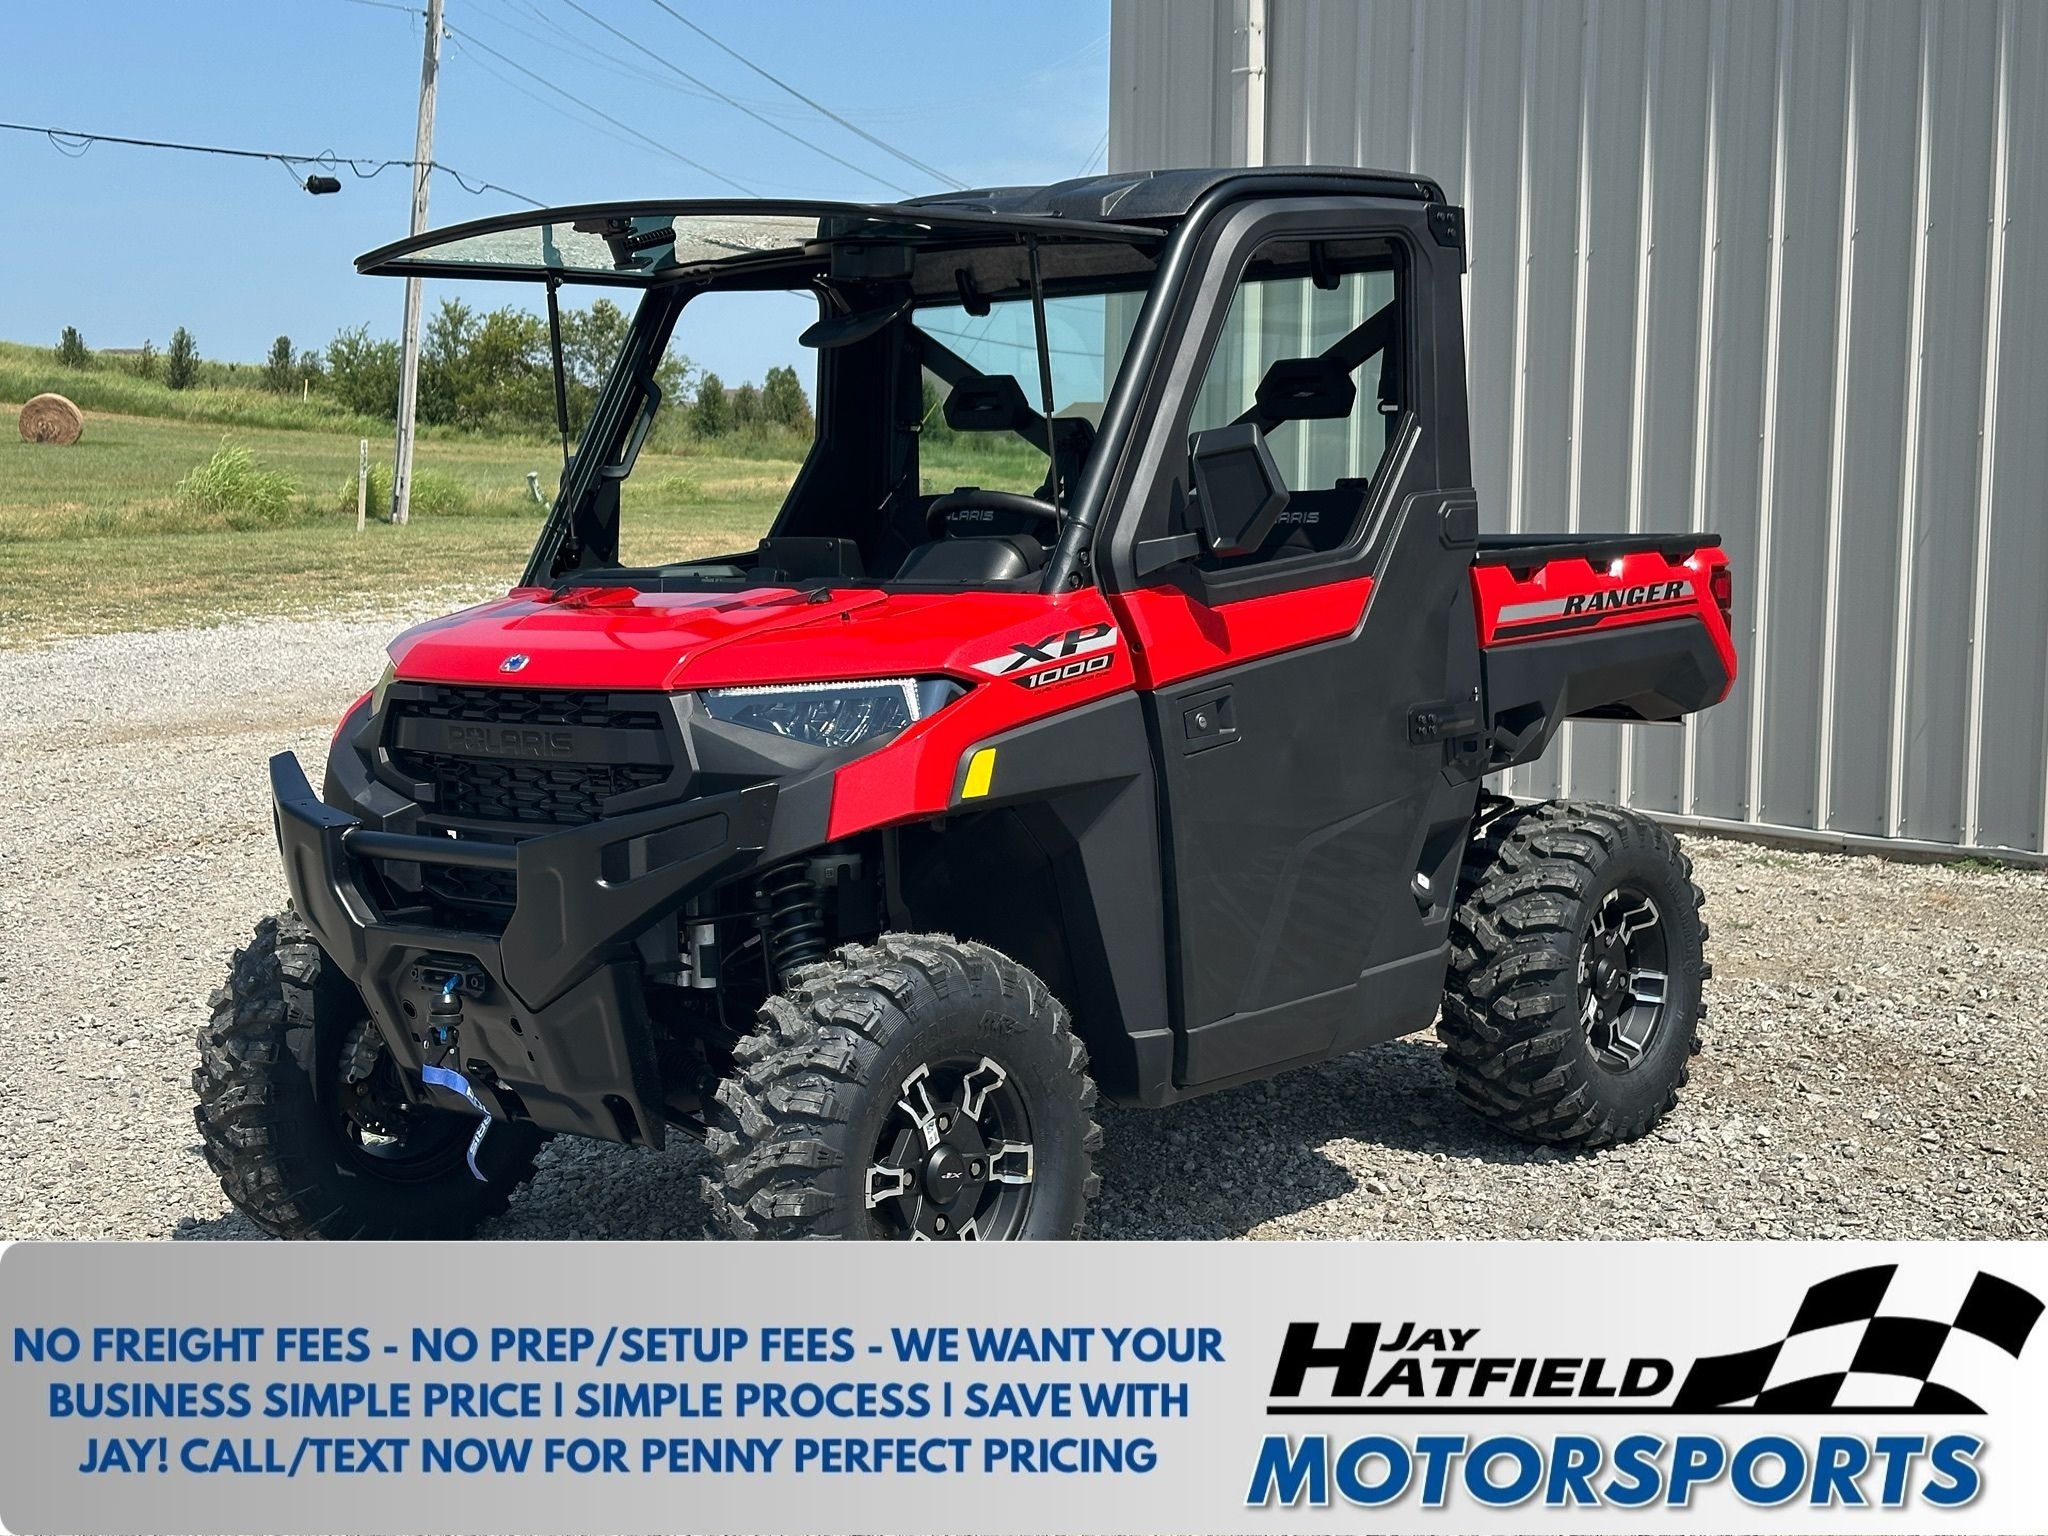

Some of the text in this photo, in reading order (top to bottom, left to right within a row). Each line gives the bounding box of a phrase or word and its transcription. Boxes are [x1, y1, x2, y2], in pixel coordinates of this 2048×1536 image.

[944, 510, 994, 521] LARIS
[1274, 511, 1320, 524] ARIS
[1563, 580, 1684, 616] RANGER
[1000, 622, 1113, 674] XP
[1028, 655, 1110, 689] 1000
[447, 725, 574, 758] POLARIS
